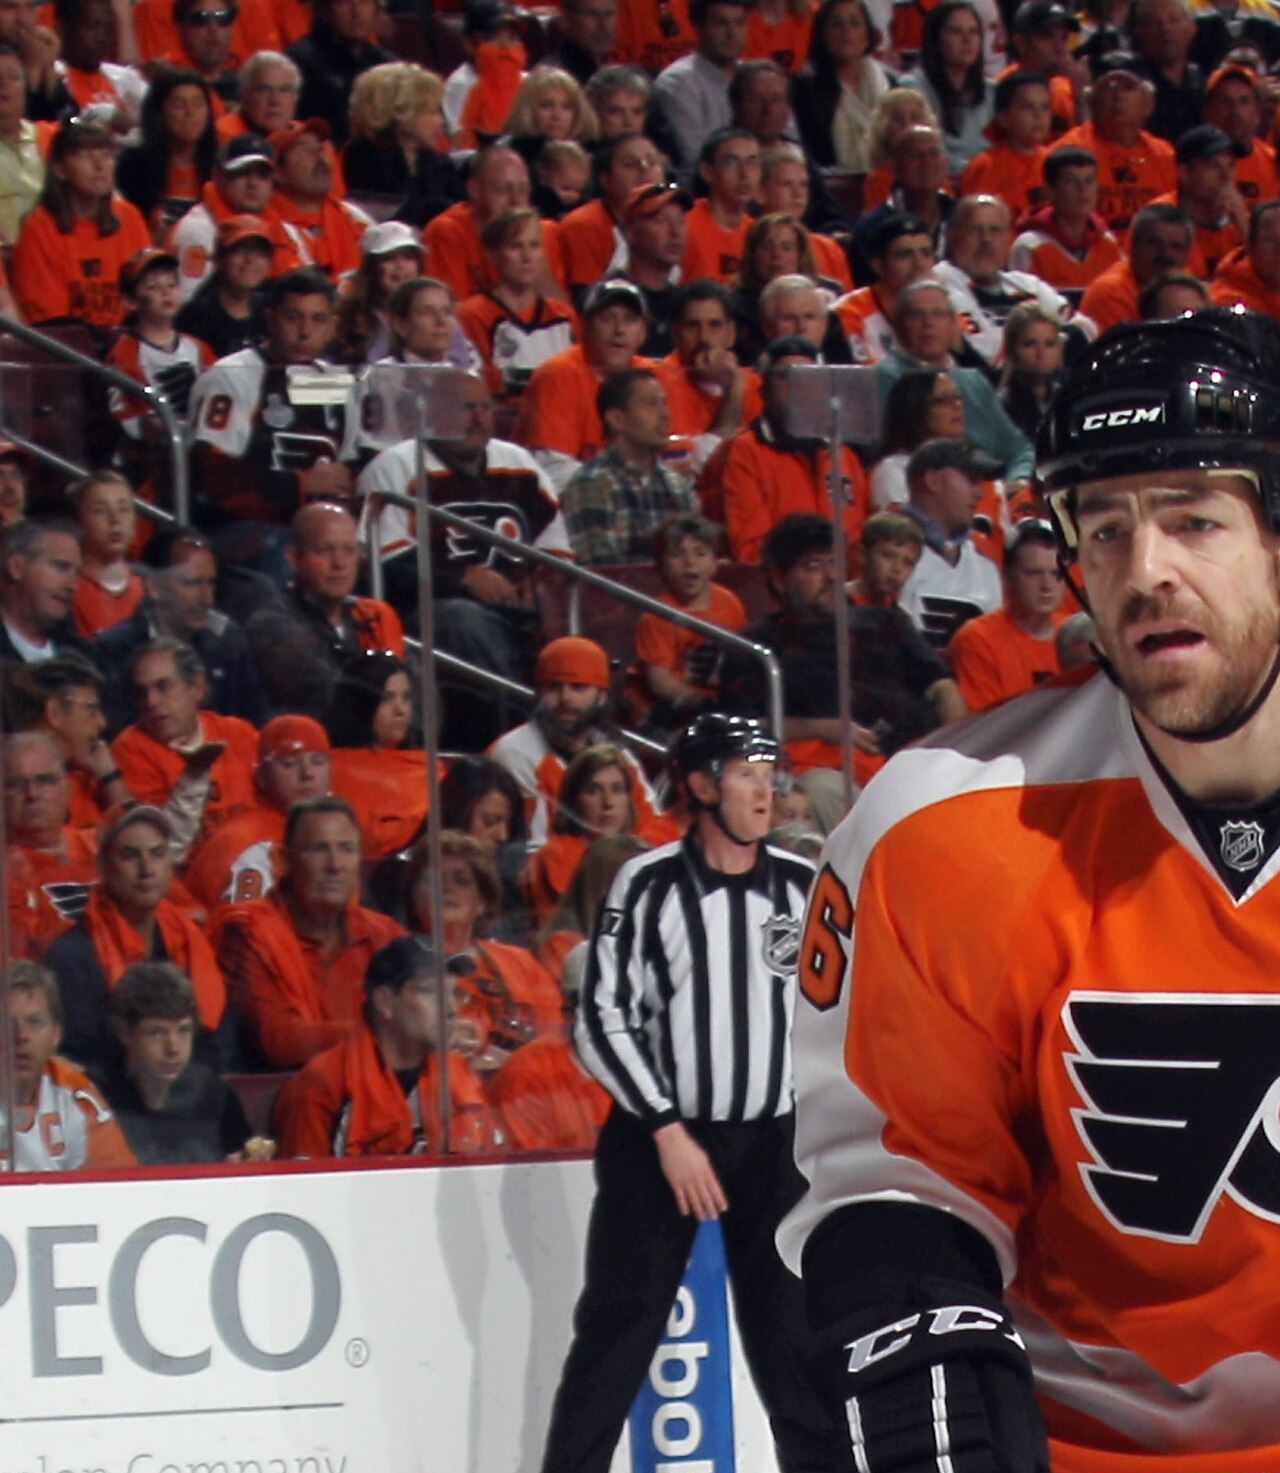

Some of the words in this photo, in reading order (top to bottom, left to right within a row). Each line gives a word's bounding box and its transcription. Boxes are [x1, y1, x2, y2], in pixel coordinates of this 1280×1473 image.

[1082, 406, 1161, 431] CCM
[799, 862, 856, 1012] 6
[0, 1212, 342, 1378] ECO
[844, 1305, 1026, 1373] CC
